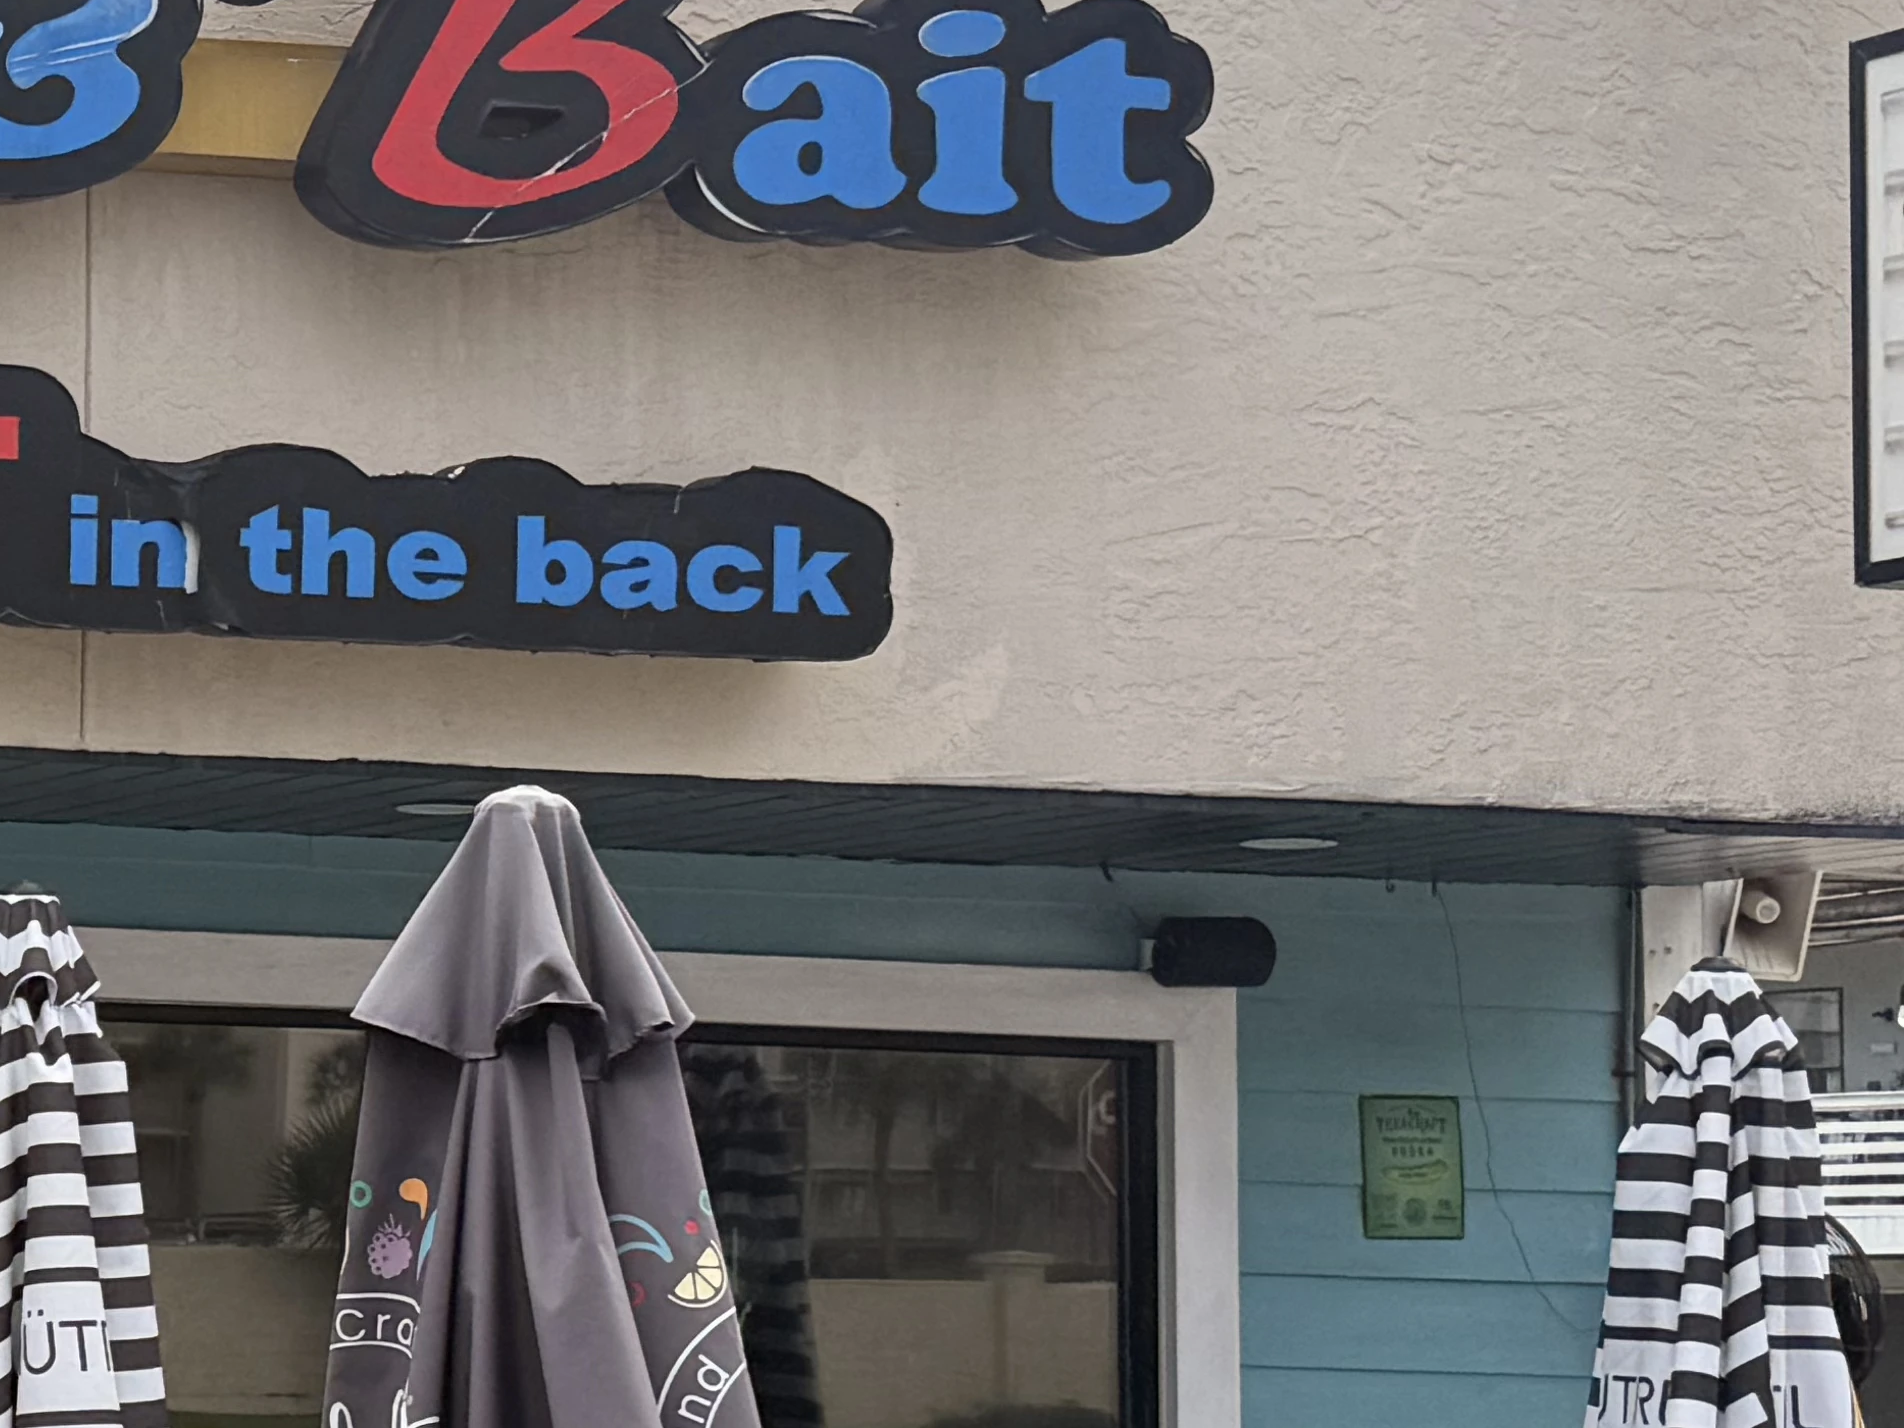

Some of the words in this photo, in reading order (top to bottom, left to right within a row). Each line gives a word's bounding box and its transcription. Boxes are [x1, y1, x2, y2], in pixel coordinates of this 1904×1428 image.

[68, 493, 196, 593] in
[239, 506, 469, 602] the
[515, 514, 854, 618] back
